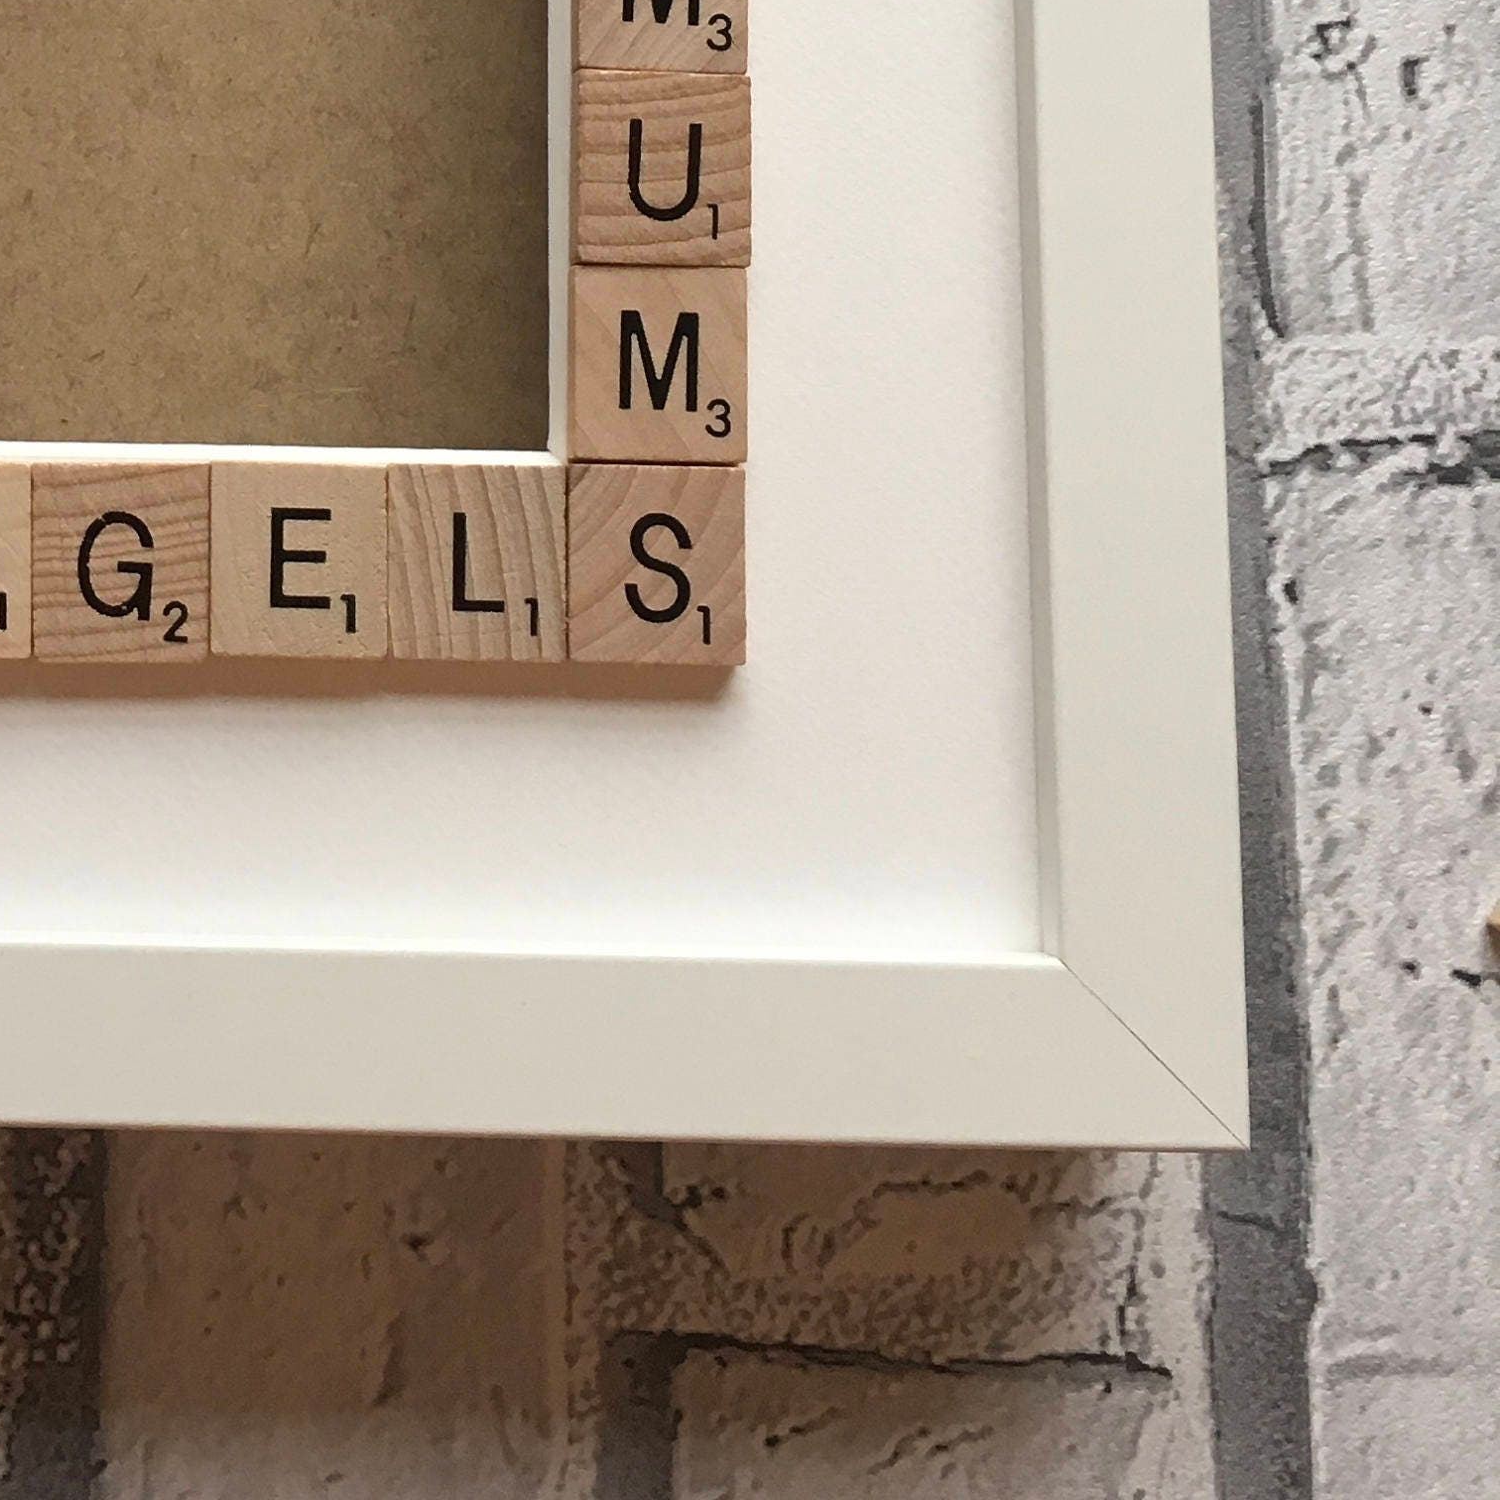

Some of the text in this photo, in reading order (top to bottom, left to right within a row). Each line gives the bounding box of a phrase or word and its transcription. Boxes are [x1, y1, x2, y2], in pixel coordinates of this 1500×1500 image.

[706, 13, 733, 52] 3
[706, 203, 720, 241] 1
[705, 398, 731, 438] 3
[162, 600, 189, 644] 2
[339, 593, 357, 634] 1
[524, 597, 539, 637] 1
[696, 605, 711, 646] 1
